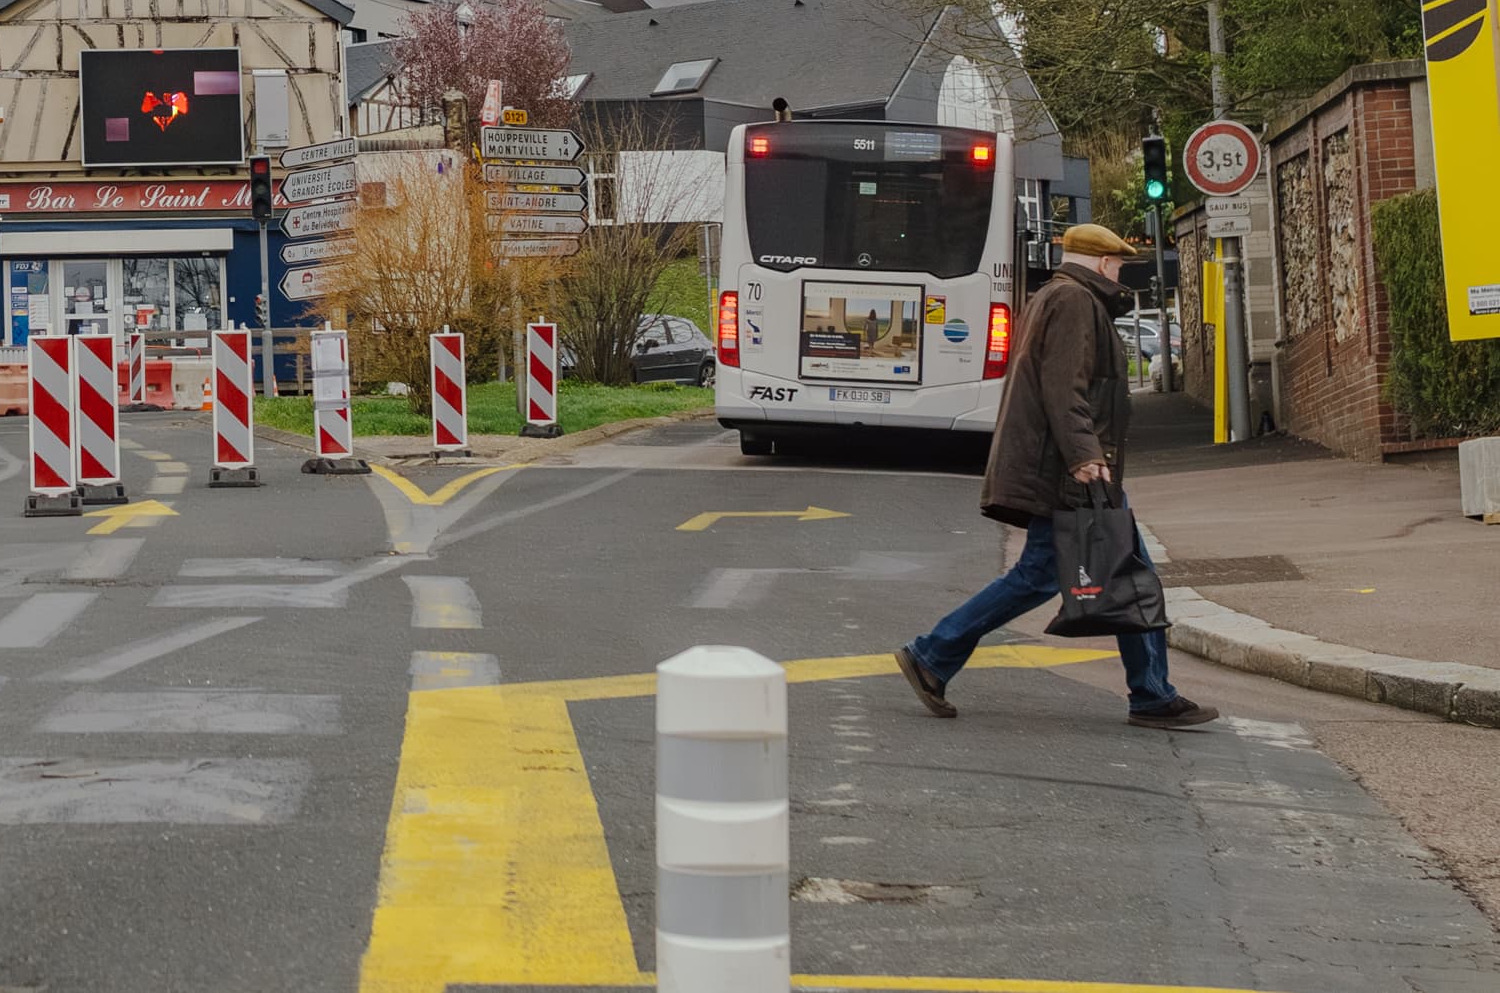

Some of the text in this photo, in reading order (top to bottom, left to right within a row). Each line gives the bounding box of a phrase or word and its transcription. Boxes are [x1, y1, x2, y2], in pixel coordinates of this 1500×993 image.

[504, 113, 525, 122] D121
[488, 133, 548, 144] HOUPPEVILLE
[853, 138, 875, 150] 5511
[301, 142, 353, 161] CENTRE VILLE
[488, 145, 569, 157] MONTVILLE 14
[1202, 151, 1243, 171] 3,5t
[291, 170, 331, 186] UNIVERSITÉ
[489, 169, 546, 181] LE VILLAGE
[26, 186, 76, 209] Bar
[93, 185, 124, 209] Le
[140, 185, 211, 208] Saint
[291, 184, 324, 198] GRANDES
[491, 196, 557, 207] SAINT-ANDRÉ
[1209, 202, 1247, 212] SAUF BUS
[302, 209, 322, 221] Centre
[510, 219, 543, 230] VATINE
[759, 254, 817, 265] CITARO
[15, 262, 30, 270] FDJ
[747, 282, 762, 301] 70
[749, 386, 798, 402] FAST
